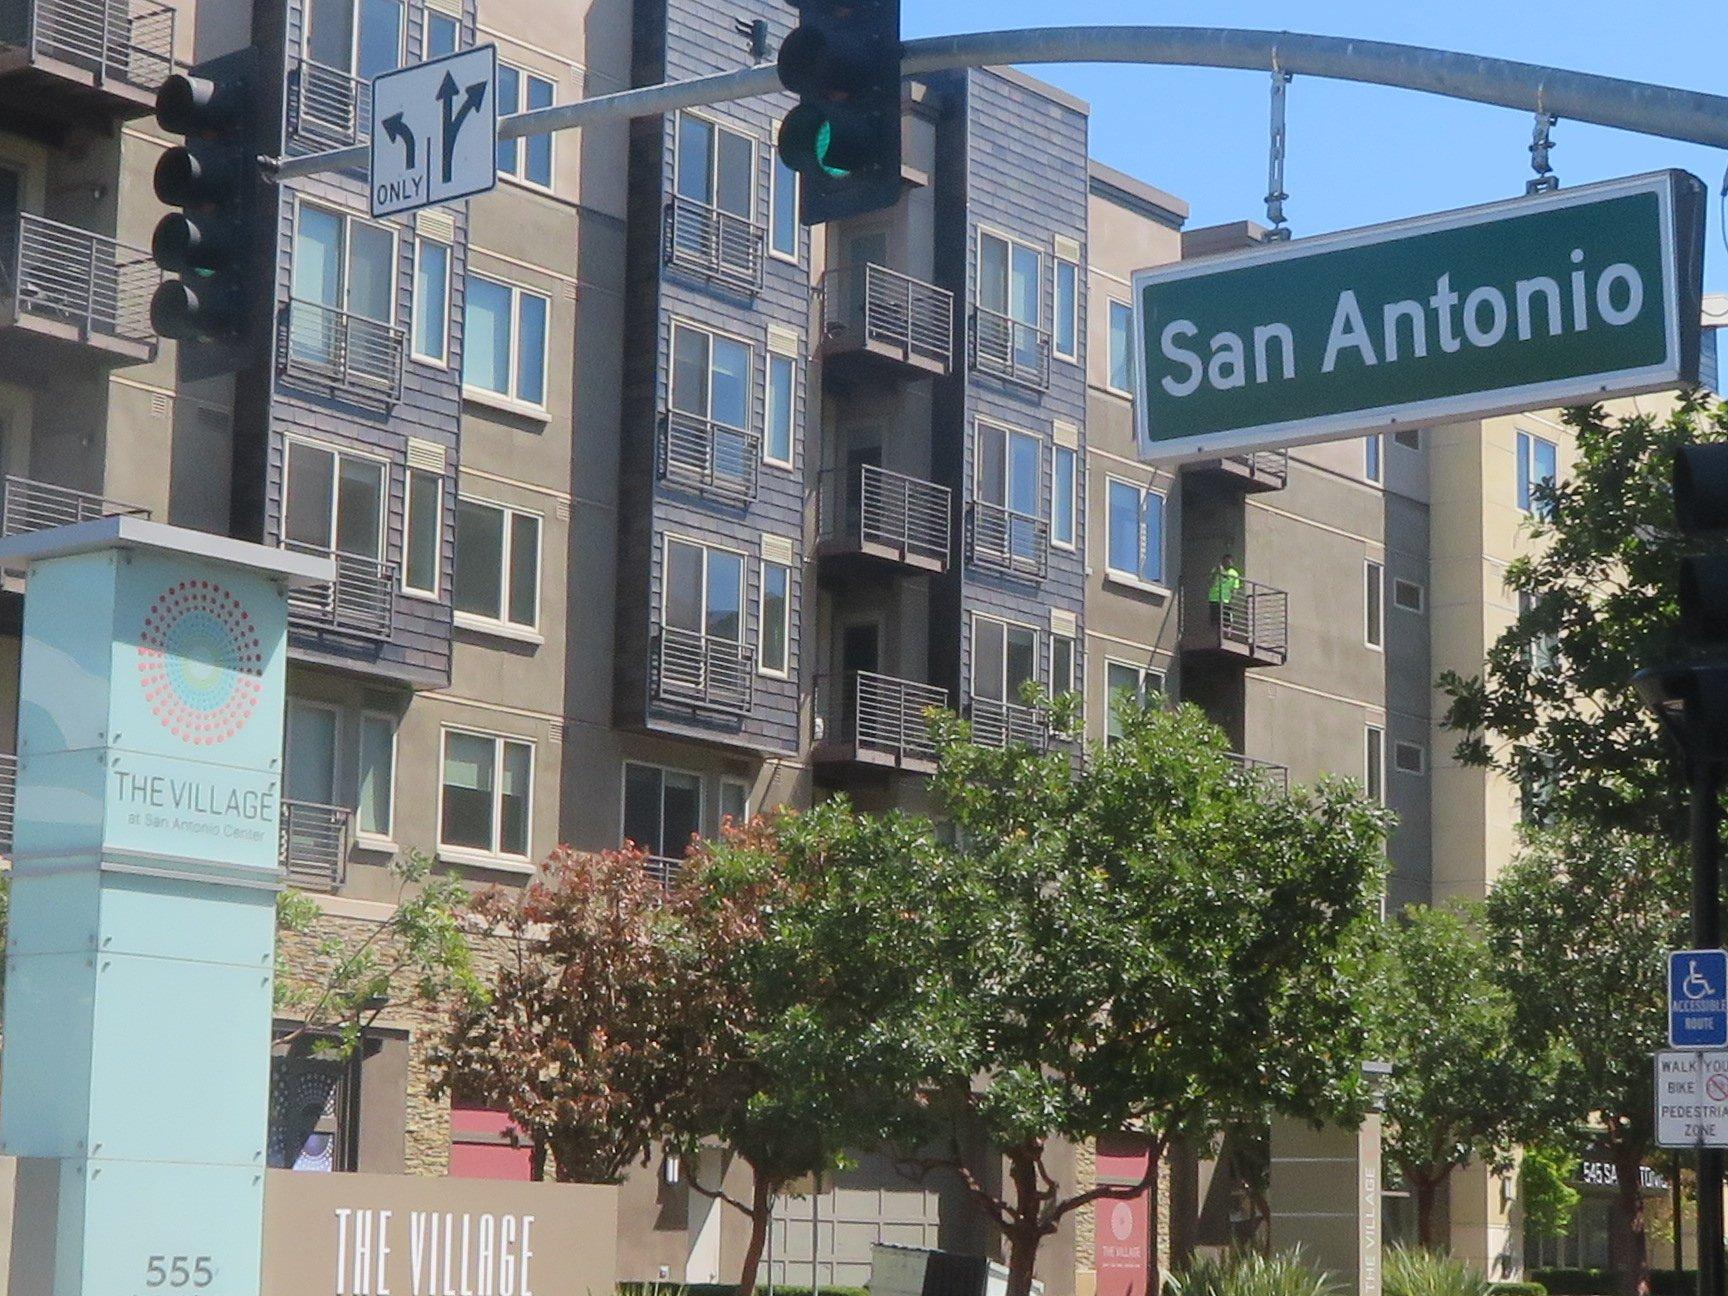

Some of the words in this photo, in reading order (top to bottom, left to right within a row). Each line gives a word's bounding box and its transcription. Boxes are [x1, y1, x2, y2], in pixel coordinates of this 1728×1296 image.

[376, 175, 423, 206] ONLY
[1159, 318, 1296, 398] San
[1321, 248, 1645, 373] Antonio
[114, 771, 165, 807] THE
[169, 778, 274, 822] VILLAGE
[128, 812, 139, 824] at
[145, 813, 168, 828] San
[173, 817, 220, 836] Antonio
[223, 823, 266, 842] Center
[1673, 1000, 1727, 1013] ACCESSIBLE
[1685, 1017, 1714, 1030] ROUTE
[1661, 1060, 1696, 1073] WALK
[1668, 1082, 1695, 1094] BIKE
[1684, 1123, 1716, 1137] ZONE
[1364, 1167, 1376, 1249] VILLAGE
[334, 1208, 392, 1296] THE
[145, 1255, 213, 1287] 555
[1364, 1256, 1376, 1293] THE
